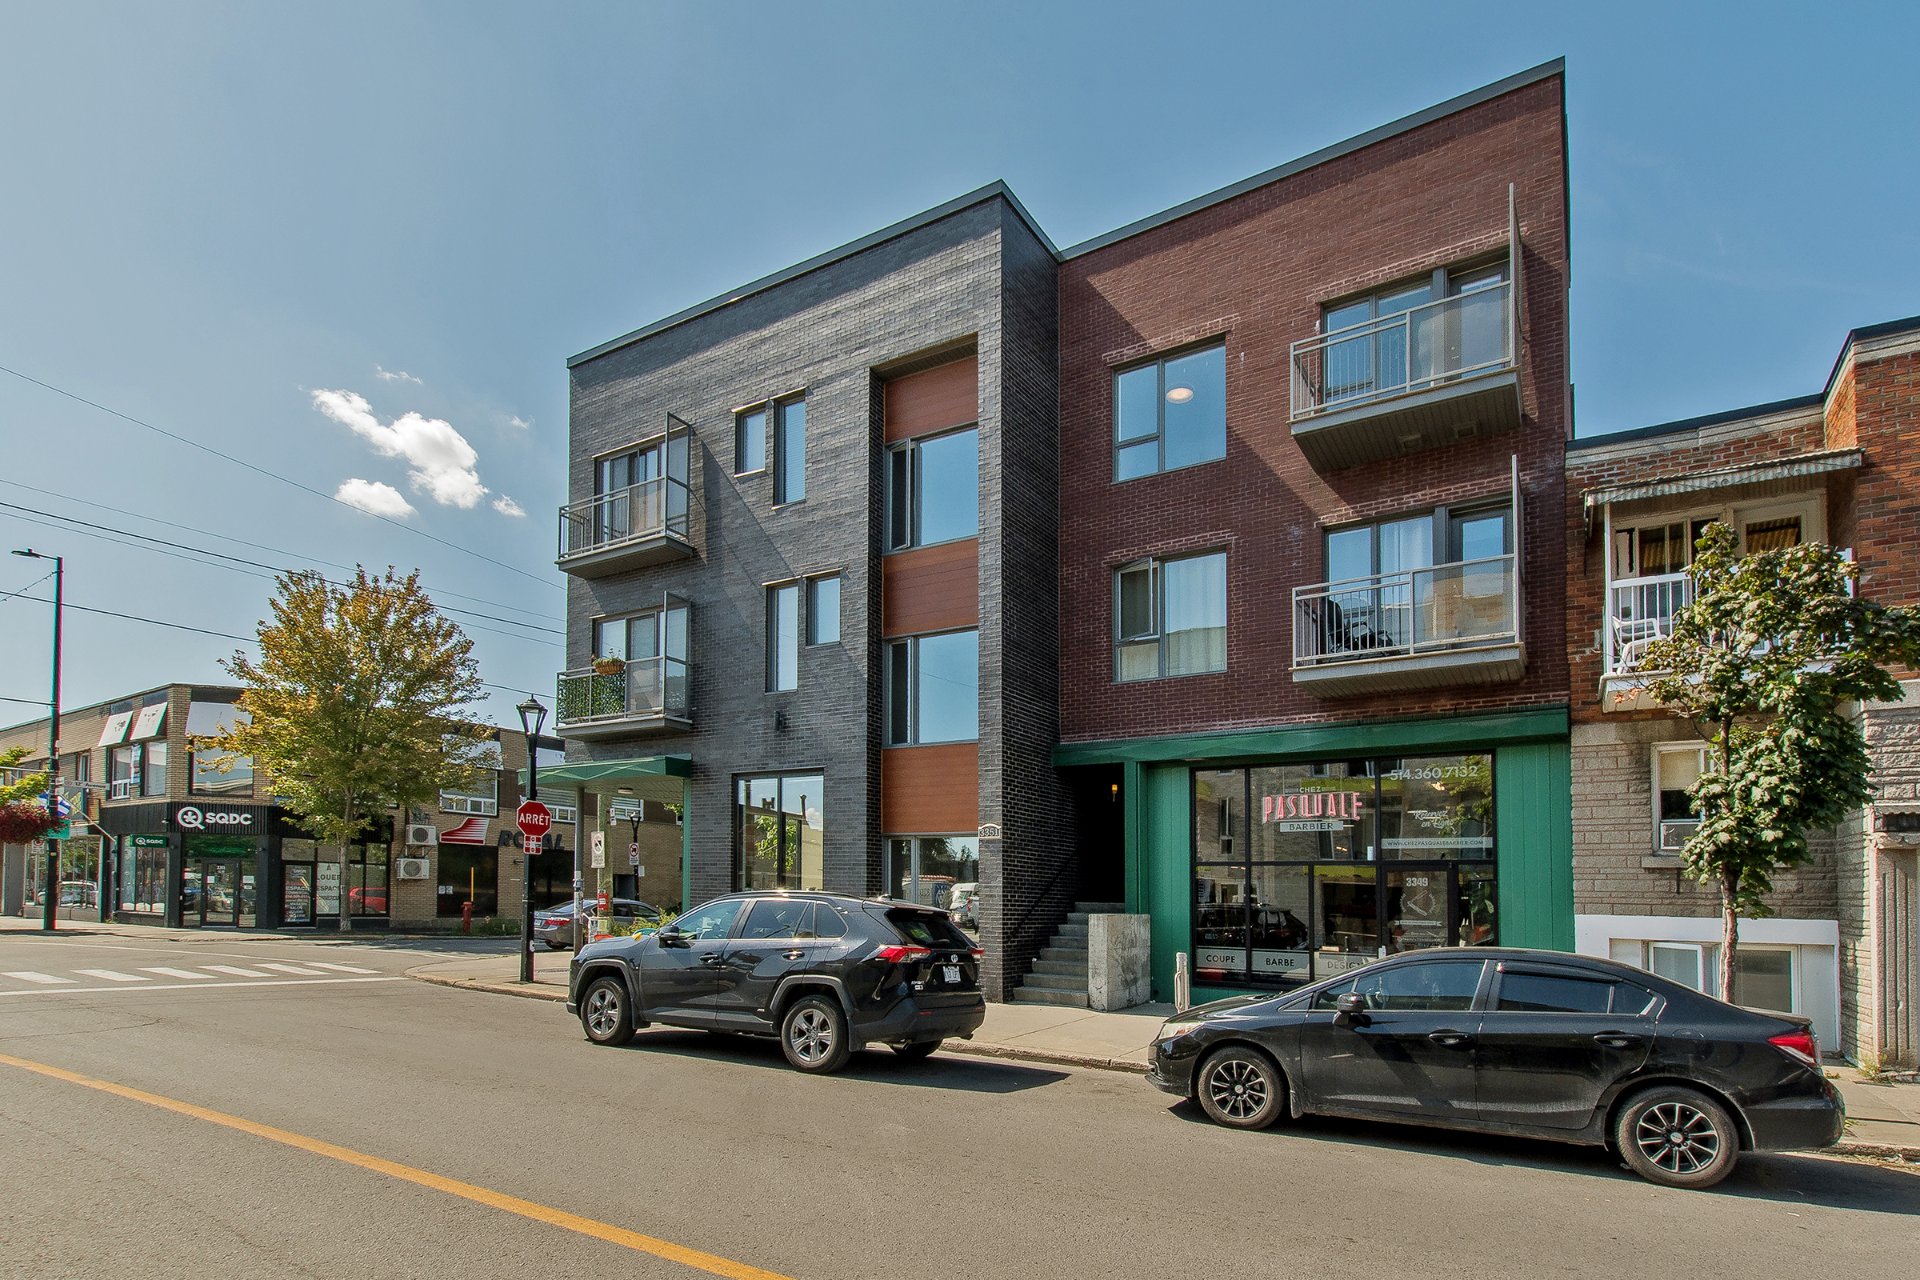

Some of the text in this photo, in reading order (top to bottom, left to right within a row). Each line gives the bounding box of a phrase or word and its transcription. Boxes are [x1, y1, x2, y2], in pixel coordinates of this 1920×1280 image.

[1390, 766, 1478, 780] 514.360.7132
[1263, 792, 1363, 823] PASQUALE
[205, 812, 253, 825] SQDC
[519, 812, 550, 826] ARRÊT
[1289, 822, 1334, 831] BARBIER
[498, 829, 565, 850] ROAL
[1406, 877, 1429, 887] 3349
[1205, 954, 1236, 964] COUPE
[1265, 957, 1295, 967] BARBE
